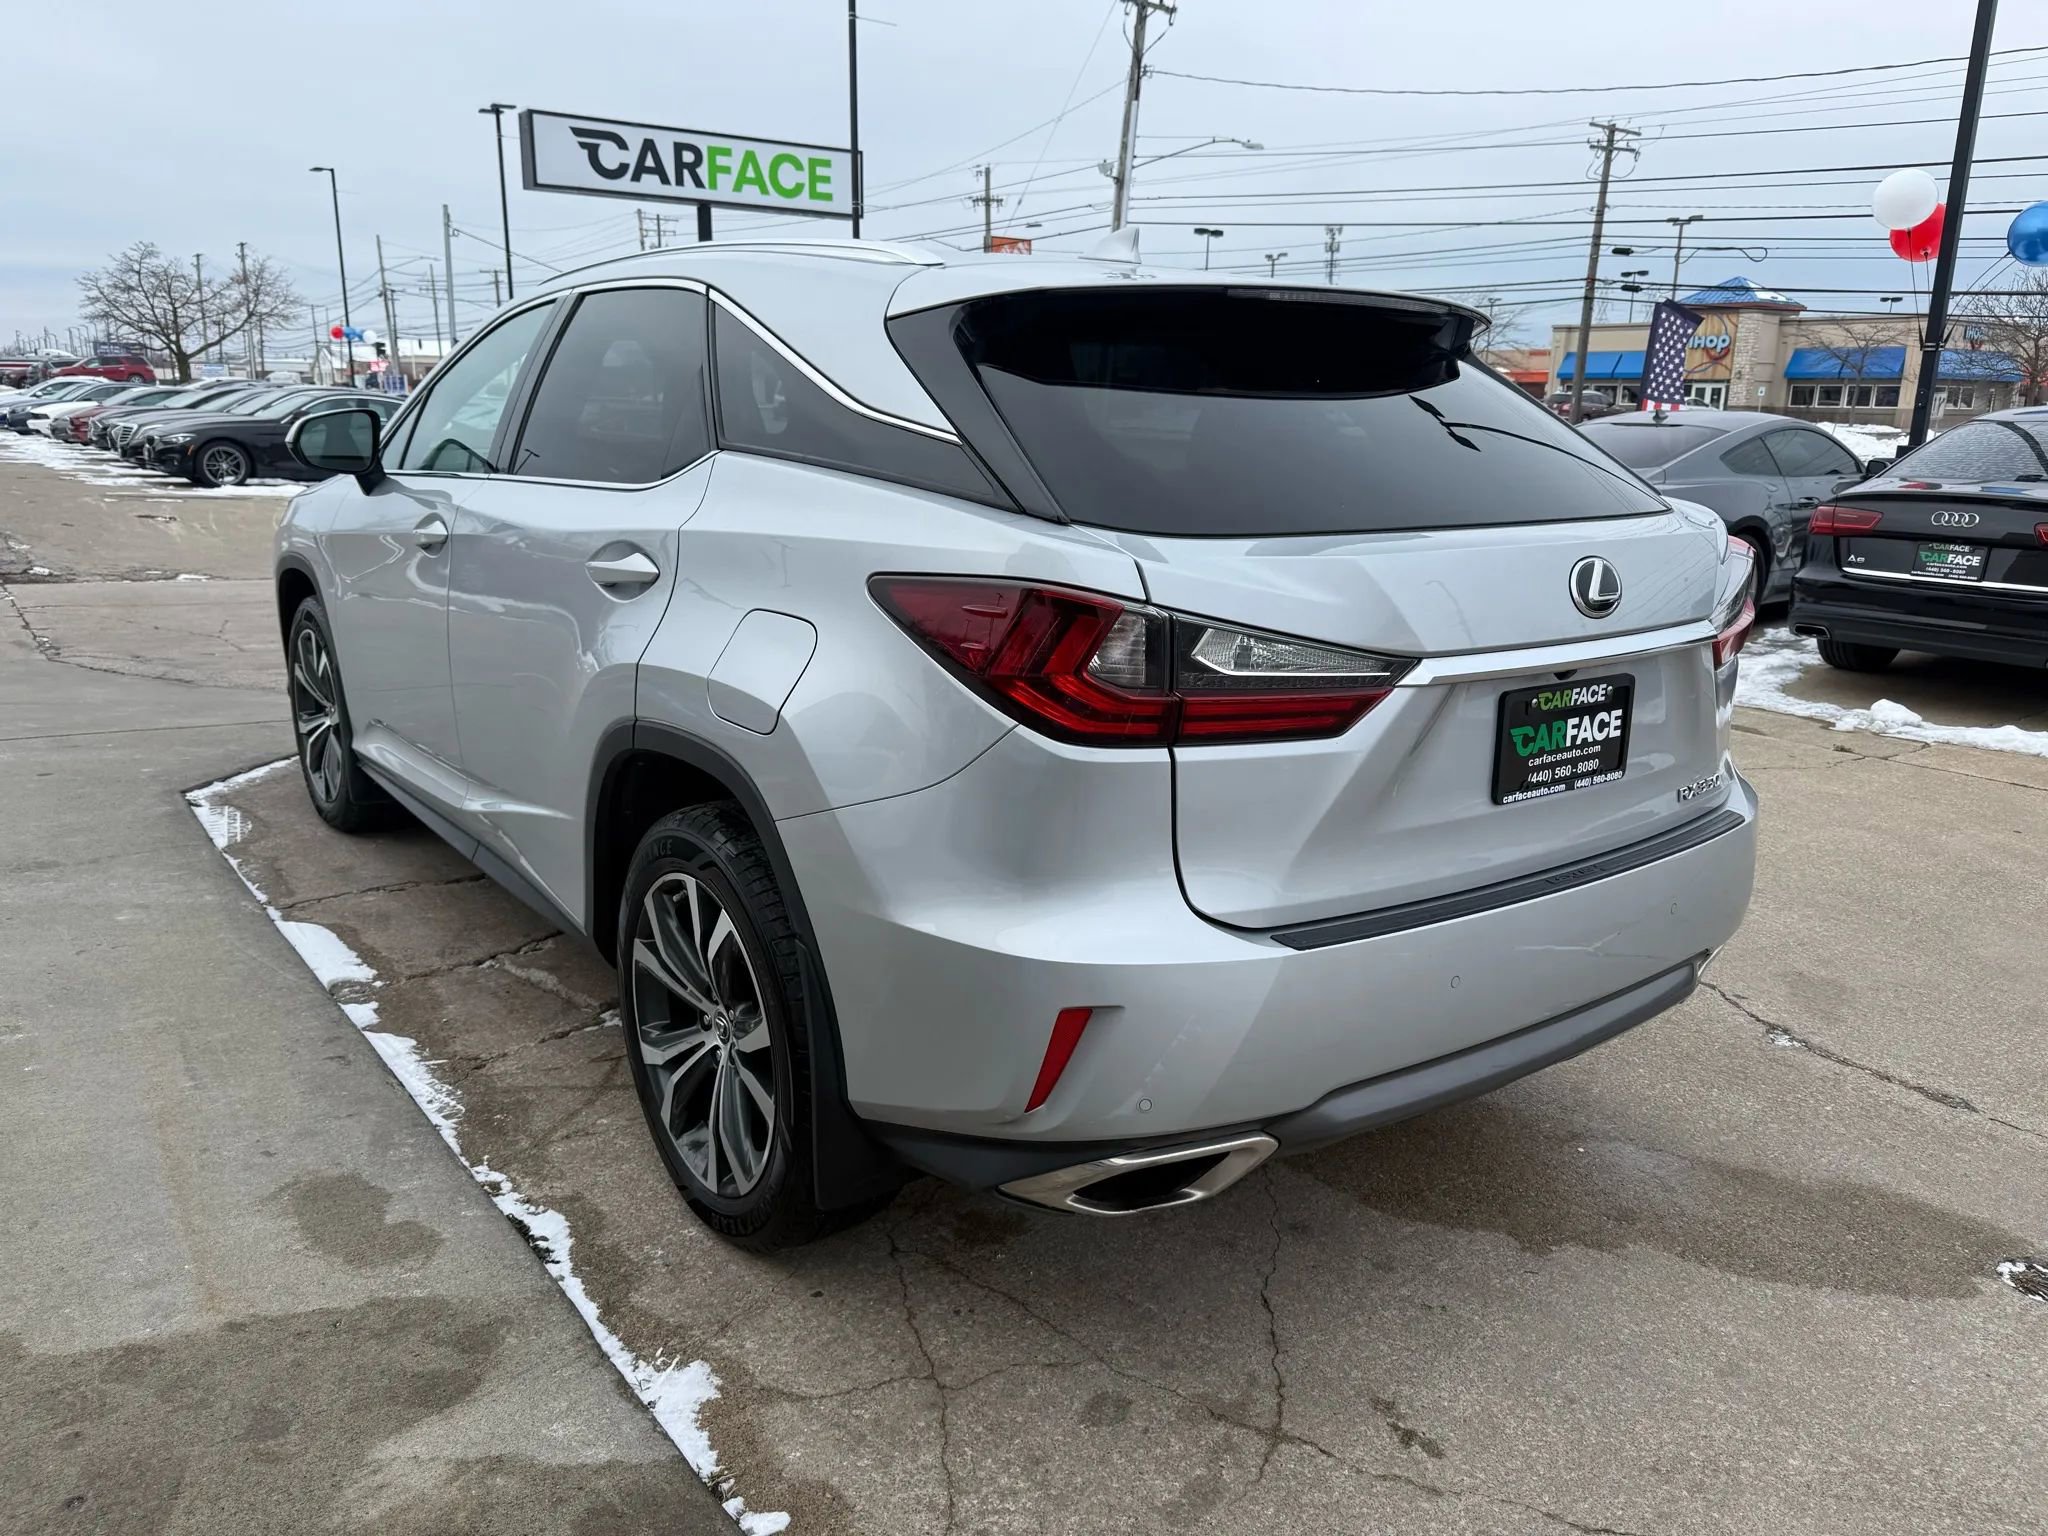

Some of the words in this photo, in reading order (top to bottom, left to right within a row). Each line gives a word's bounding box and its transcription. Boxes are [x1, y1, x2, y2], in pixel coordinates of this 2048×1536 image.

[568, 126, 833, 202] CARFACE
[1920, 551, 1982, 566] CARFACE
[1932, 543, 1971, 553] CARFACE
[1538, 683, 1607, 711] CARFACE
[1510, 709, 1623, 757] CARFACE
[1528, 745, 1601, 767] carfaceauto.com
[1528, 769, 1552, 784] (440)
[1503, 784, 1566, 804] carfaceauto.com
[1574, 778, 1592, 790] (440)
